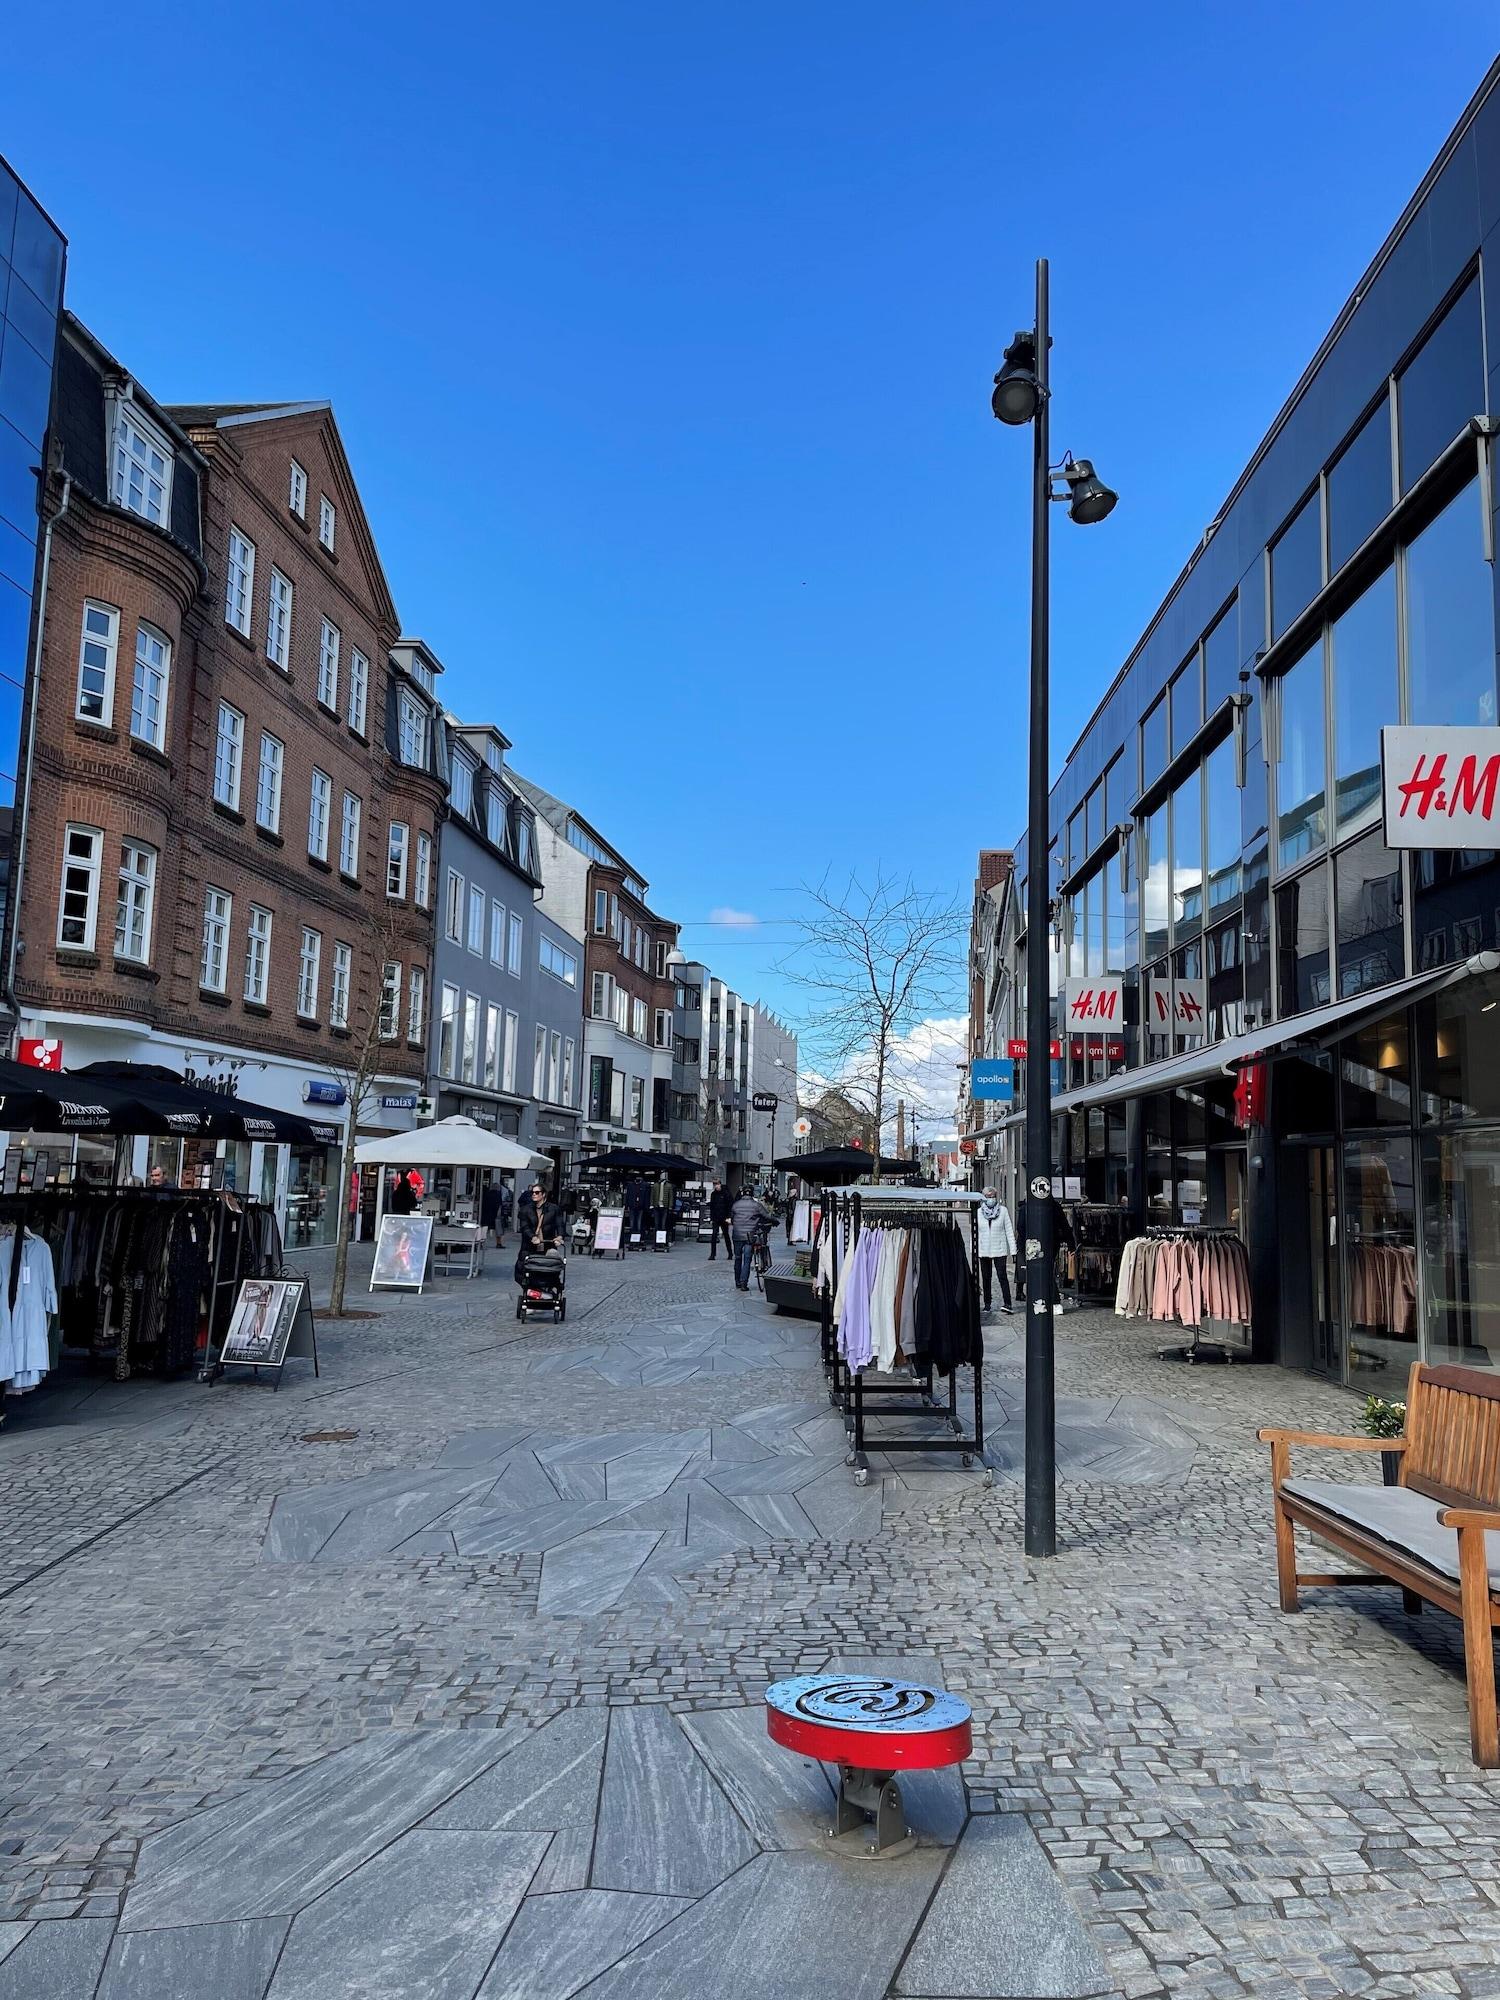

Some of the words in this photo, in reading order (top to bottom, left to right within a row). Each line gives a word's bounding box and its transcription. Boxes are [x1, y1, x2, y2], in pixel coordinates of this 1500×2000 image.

[1398, 754, 1500, 820] H&M
[1071, 990, 1118, 1020] H&M
[977, 1074, 1003, 1084] apollo
